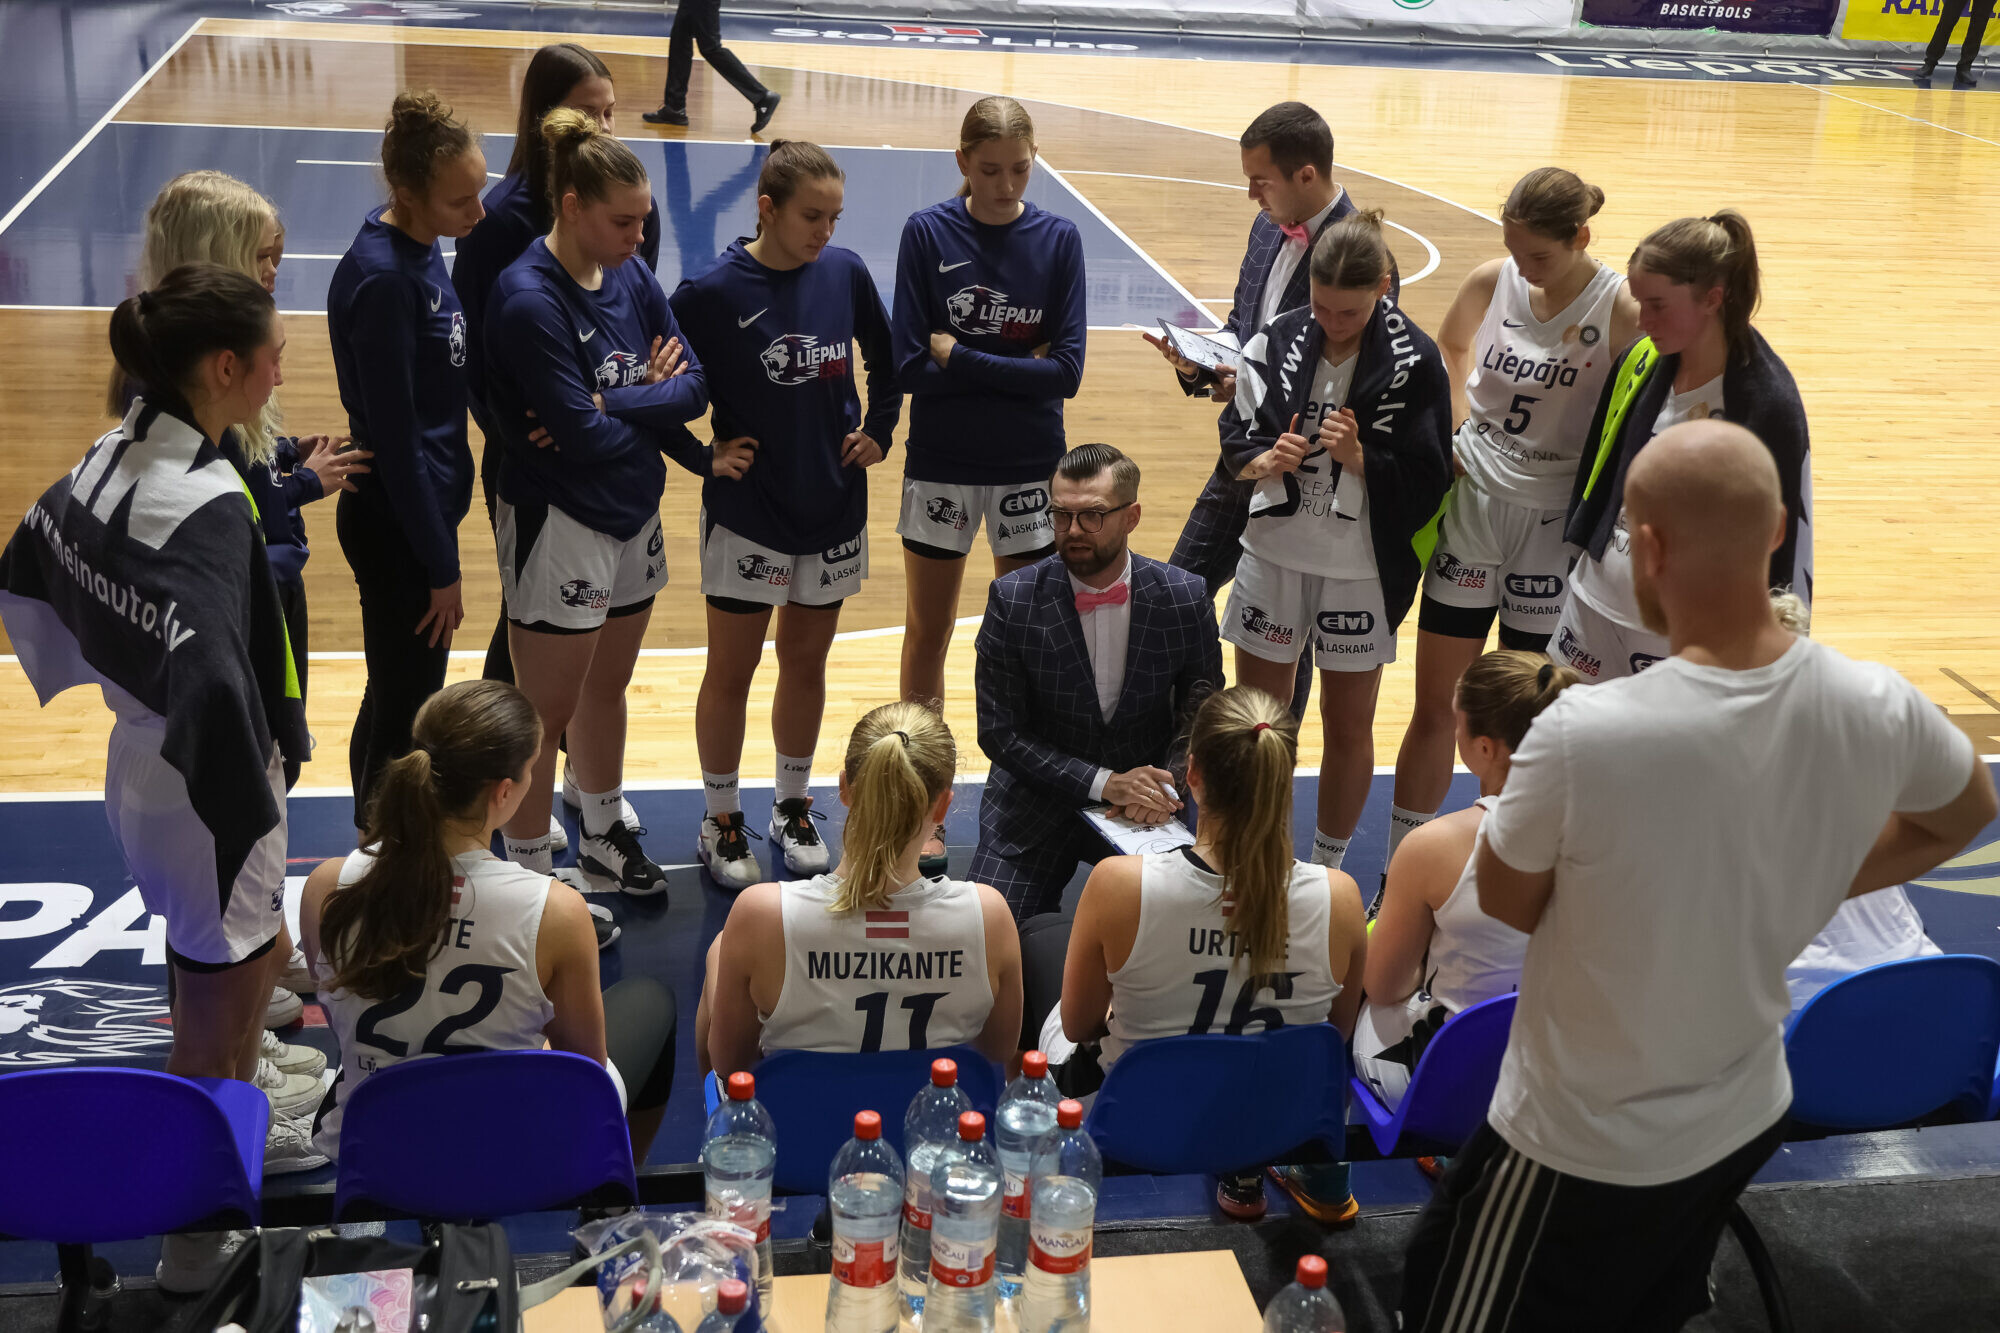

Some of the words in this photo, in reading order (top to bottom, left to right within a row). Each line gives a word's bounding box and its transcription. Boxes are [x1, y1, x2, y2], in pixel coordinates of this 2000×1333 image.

[1660, 3, 1752, 19] BASKETBOLS
[770, 27, 980, 45] Stena
[992, 36, 1139, 52] Line
[1535, 52, 1916, 81] Liepāja
[1483, 344, 1579, 389] Liepāja
[1503, 394, 1543, 435] 5
[1458, 577, 1486, 589] LSSS
[1511, 603, 1560, 615] LASKANA
[1264, 632, 1292, 645] LSSS
[1326, 642, 1375, 654] LASKANA
[1570, 657, 1600, 678] LSSS
[808, 950, 963, 980] MUZIKANTE
[355, 963, 519, 1058] 22
[1187, 969, 1306, 1036] 16
[854, 991, 951, 1054] 11
